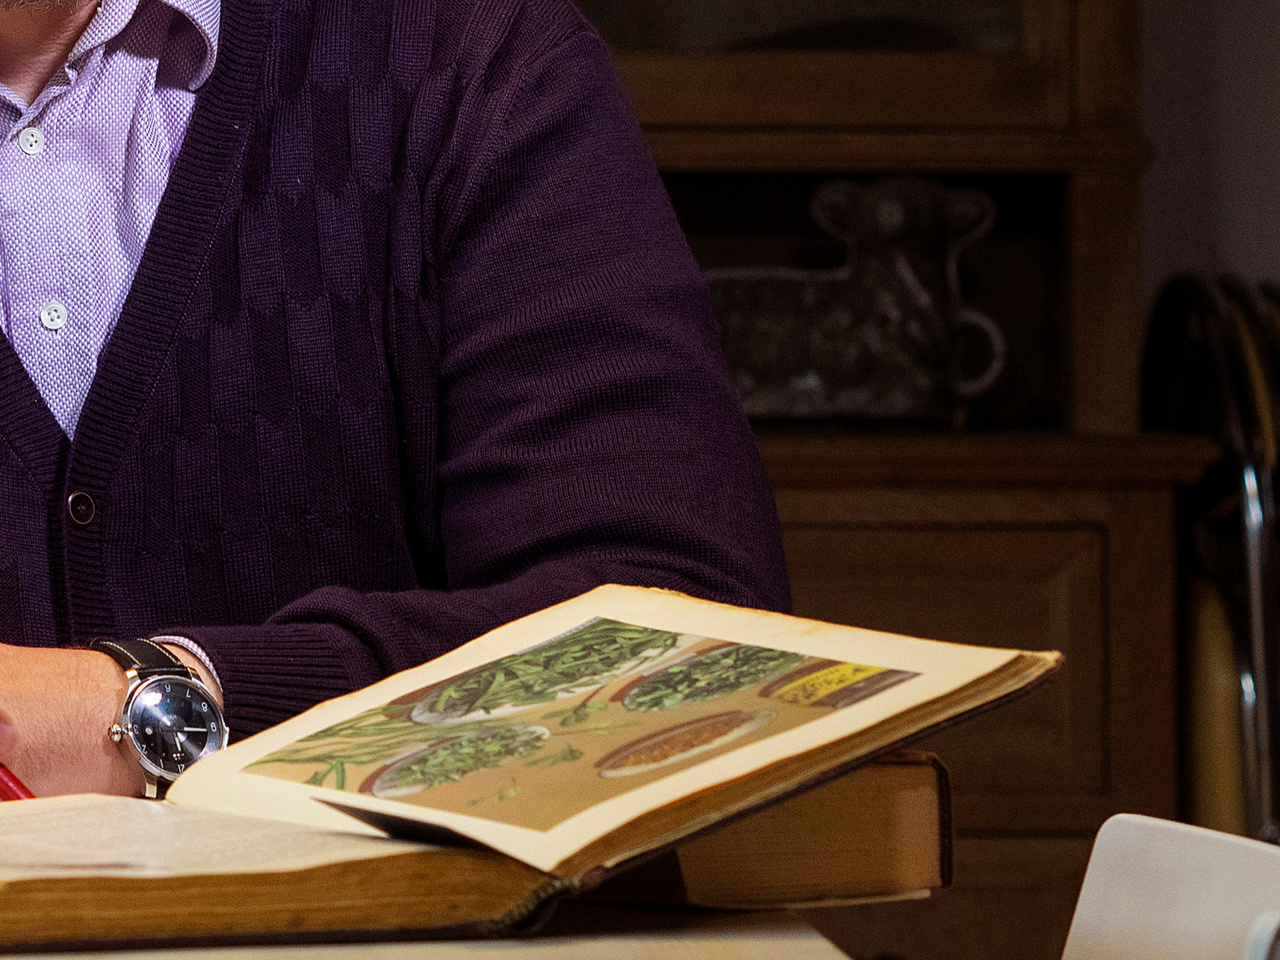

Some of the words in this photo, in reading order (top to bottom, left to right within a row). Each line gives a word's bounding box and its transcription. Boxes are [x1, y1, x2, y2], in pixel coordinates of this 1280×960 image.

[186, 688, 191, 698] 7
[201, 702, 208, 712] 8
[133, 724, 139, 734] 3
[141, 744, 148, 754] 2
